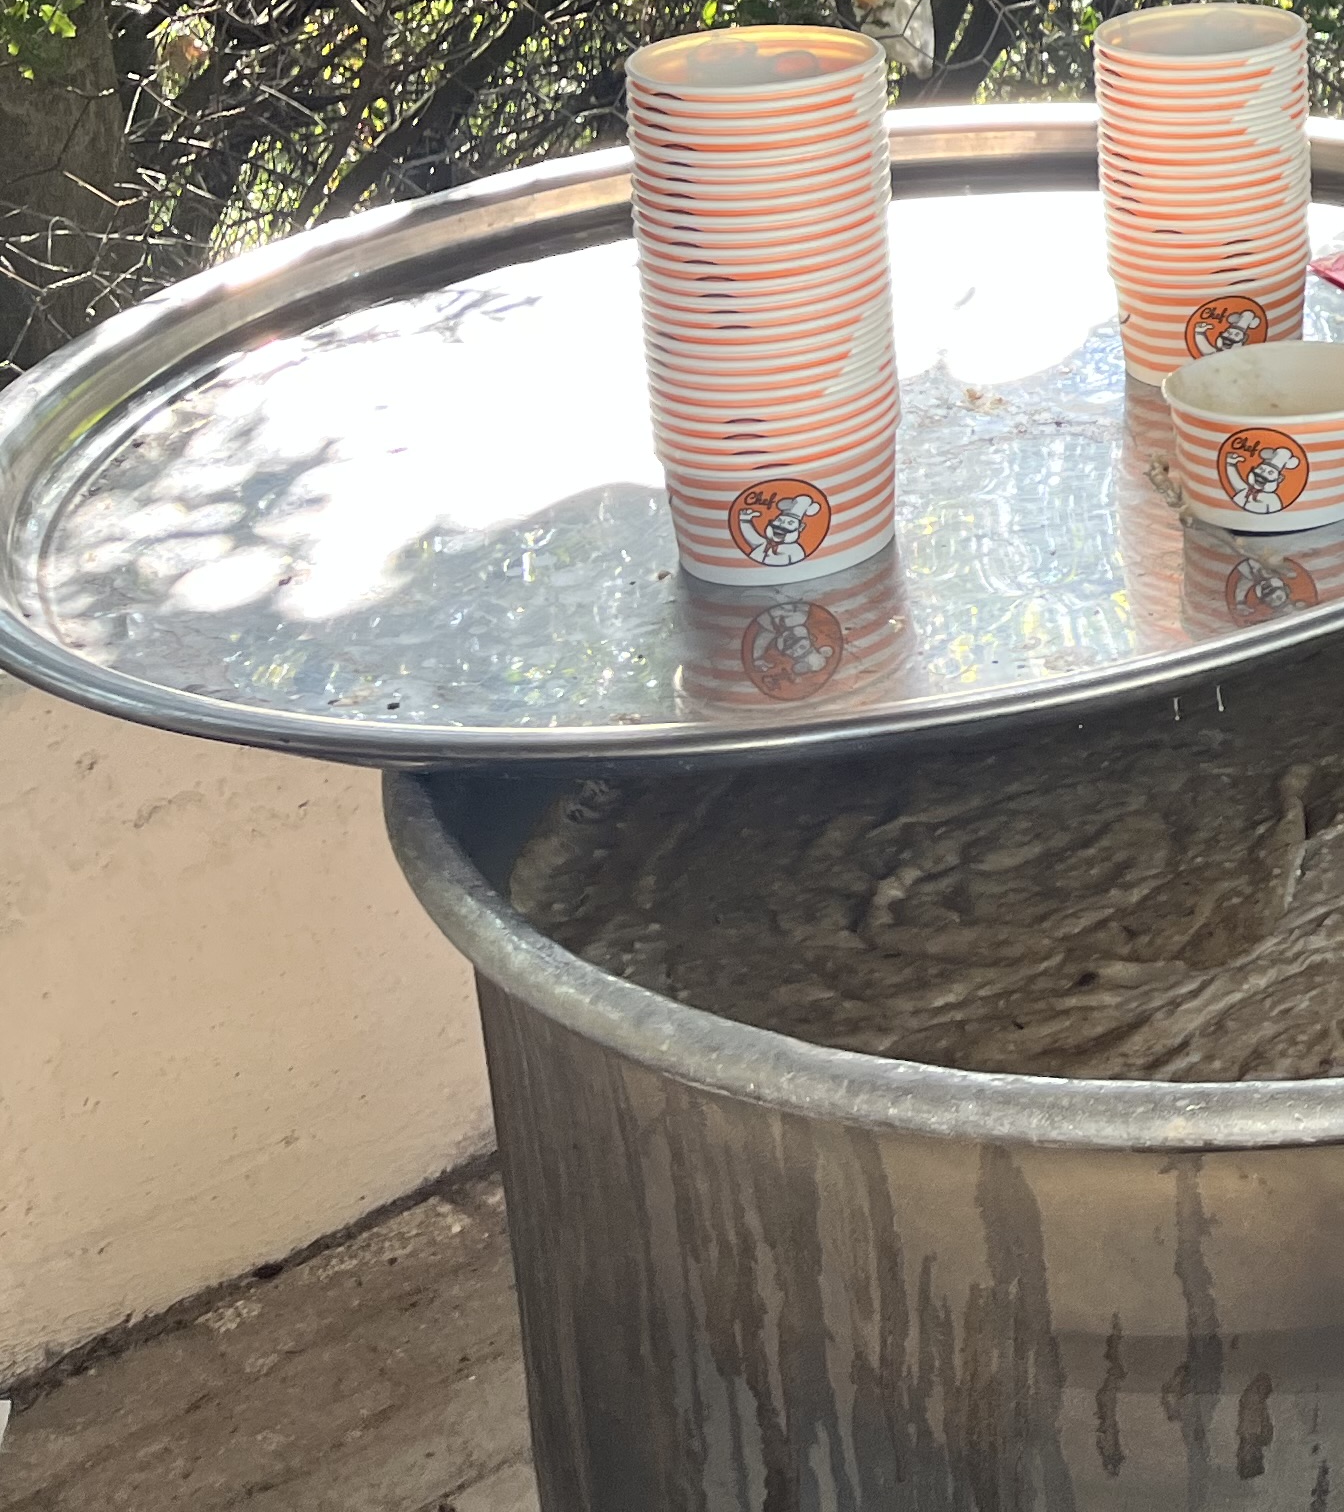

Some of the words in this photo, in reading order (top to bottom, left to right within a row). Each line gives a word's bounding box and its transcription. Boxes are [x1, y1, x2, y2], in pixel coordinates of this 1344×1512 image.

[1200, 307, 1226, 322] Chef
[1231, 437, 1259, 457] Chef
[744, 492, 776, 510] Chef
